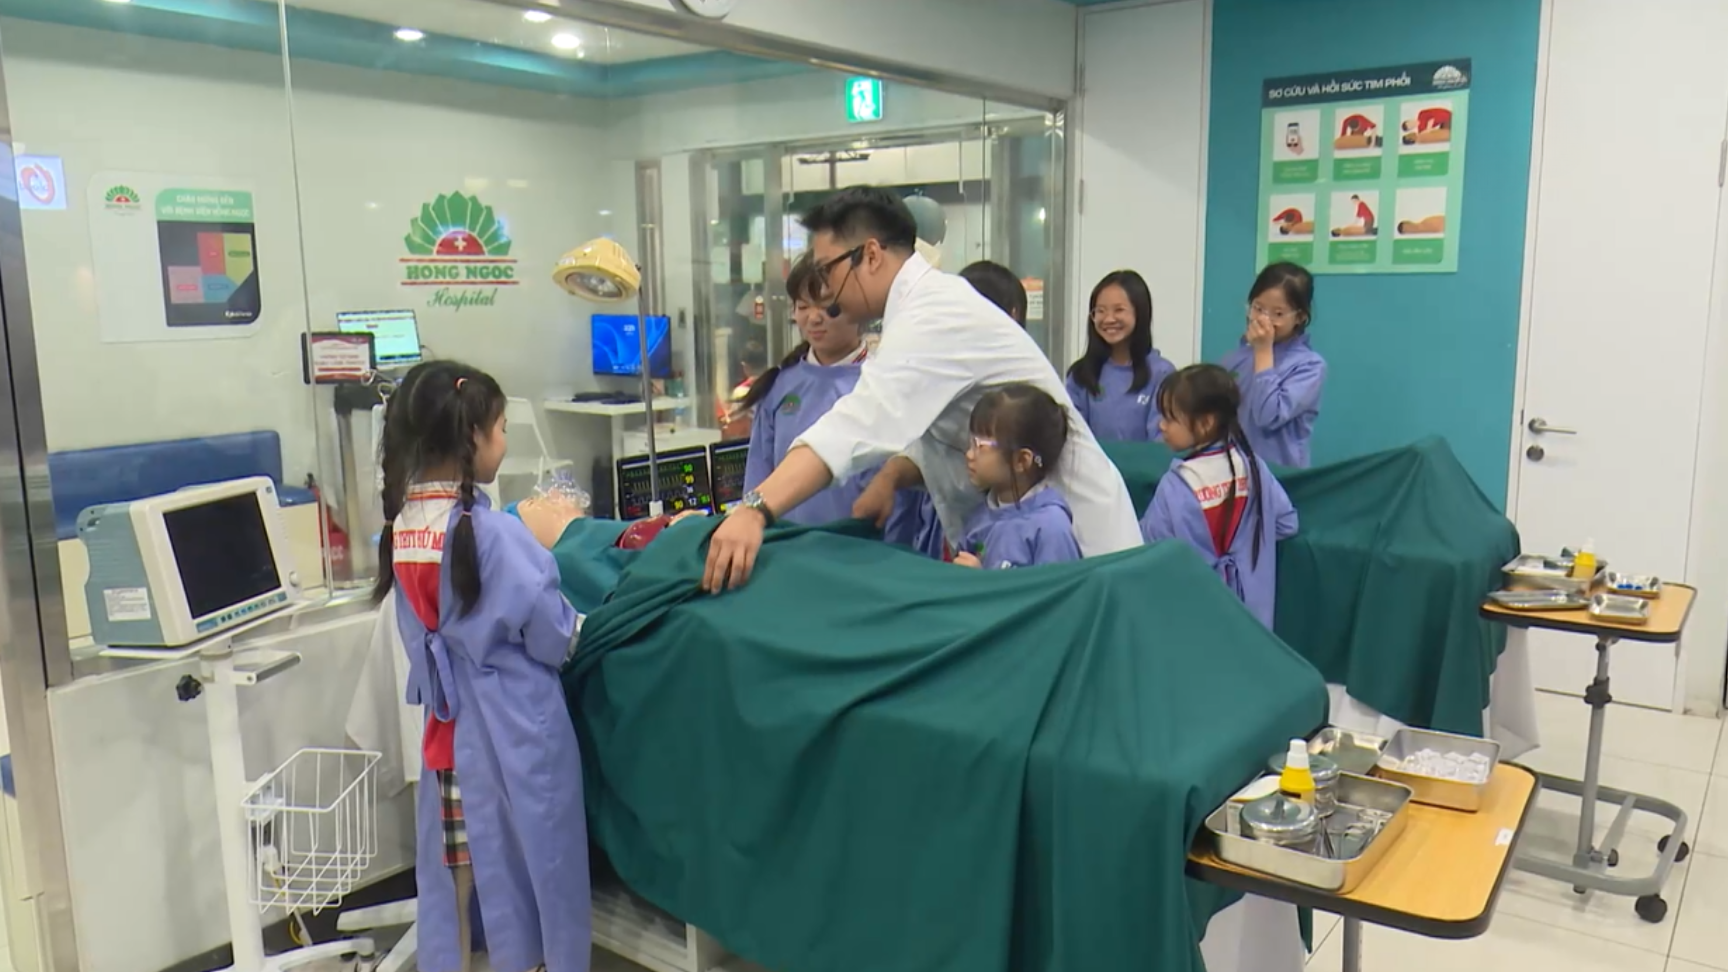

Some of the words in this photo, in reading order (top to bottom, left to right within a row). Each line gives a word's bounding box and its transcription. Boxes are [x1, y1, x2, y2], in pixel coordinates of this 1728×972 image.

[1268, 88, 1283, 99] SƠ
[1284, 84, 1306, 98] CỨU
[1307, 82, 1320, 95] VÀ
[1341, 79, 1363, 92] SỨC
[1364, 79, 1384, 91] TIM
[406, 265, 459, 280] HONG
[465, 264, 514, 279] NGOC
[427, 287, 498, 312] Hospital
